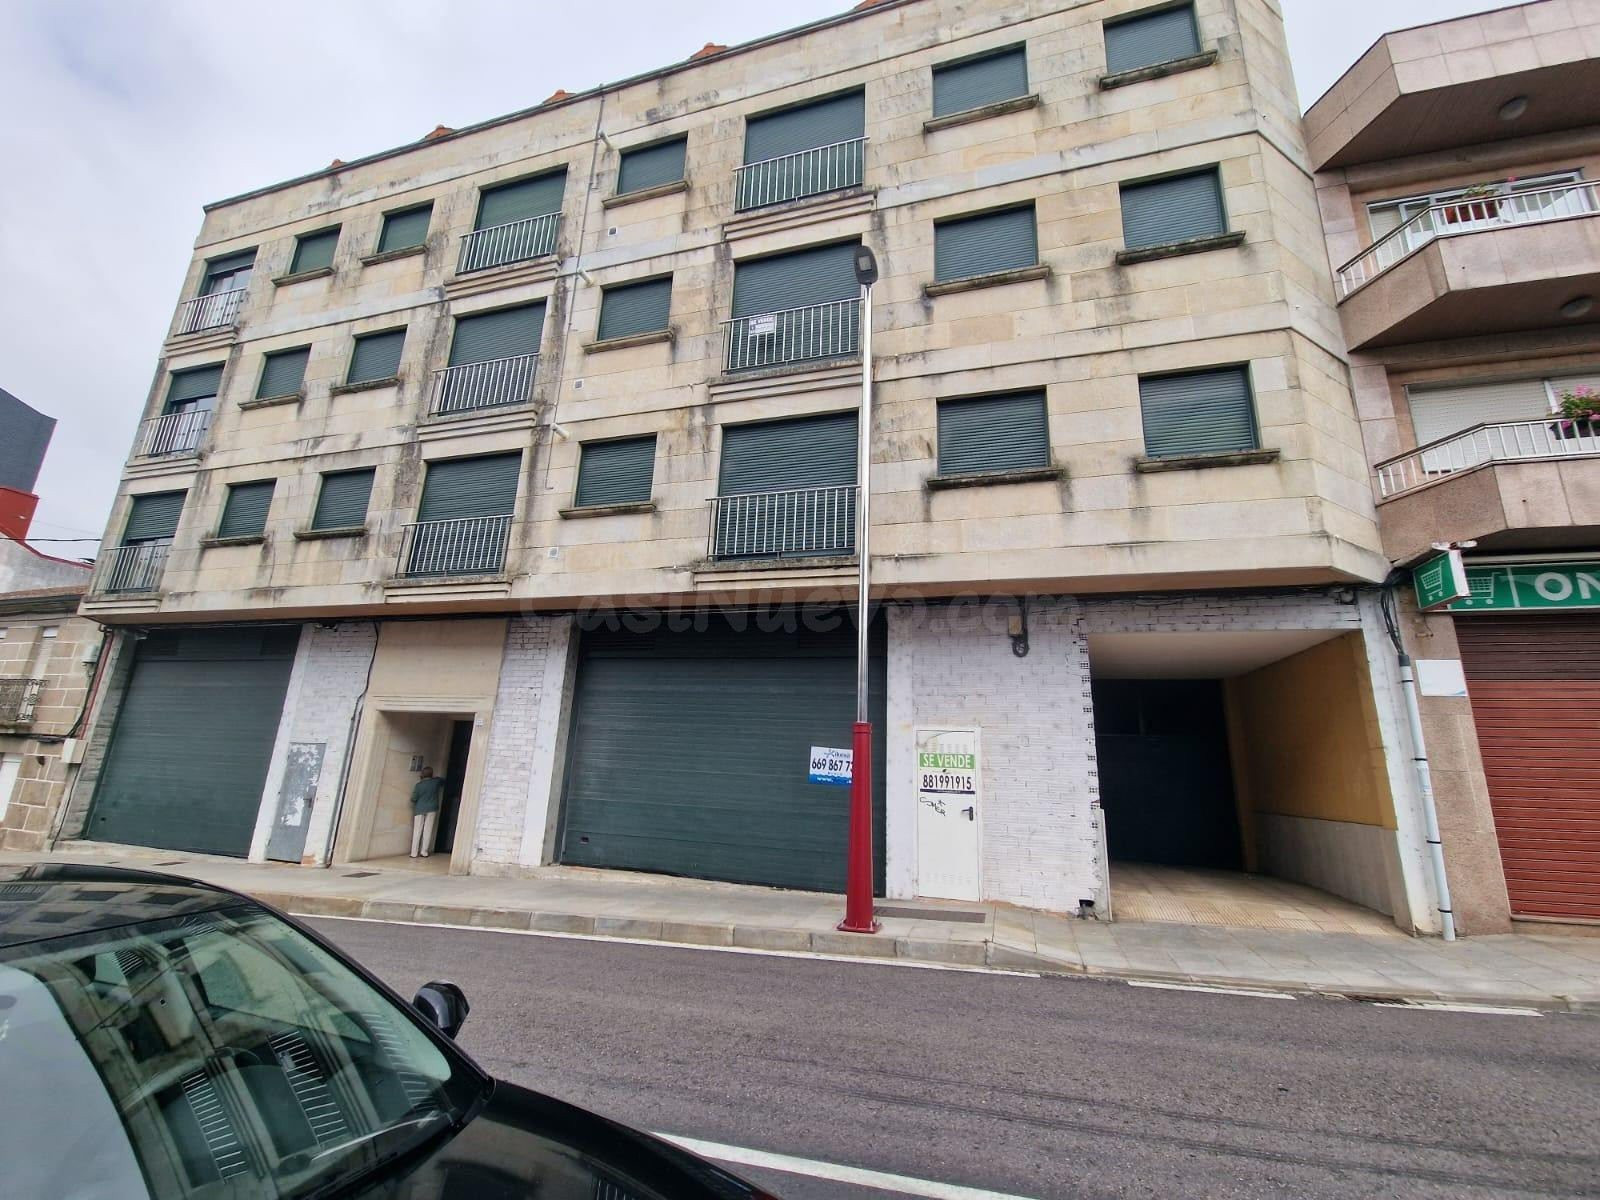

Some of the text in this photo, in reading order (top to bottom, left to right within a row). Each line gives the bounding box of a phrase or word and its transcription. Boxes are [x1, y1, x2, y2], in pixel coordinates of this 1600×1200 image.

[811, 758, 827, 770] 669
[828, 759, 844, 771] 867
[923, 754, 971, 768] SE VENDE
[922, 774, 972, 790] 881991915
